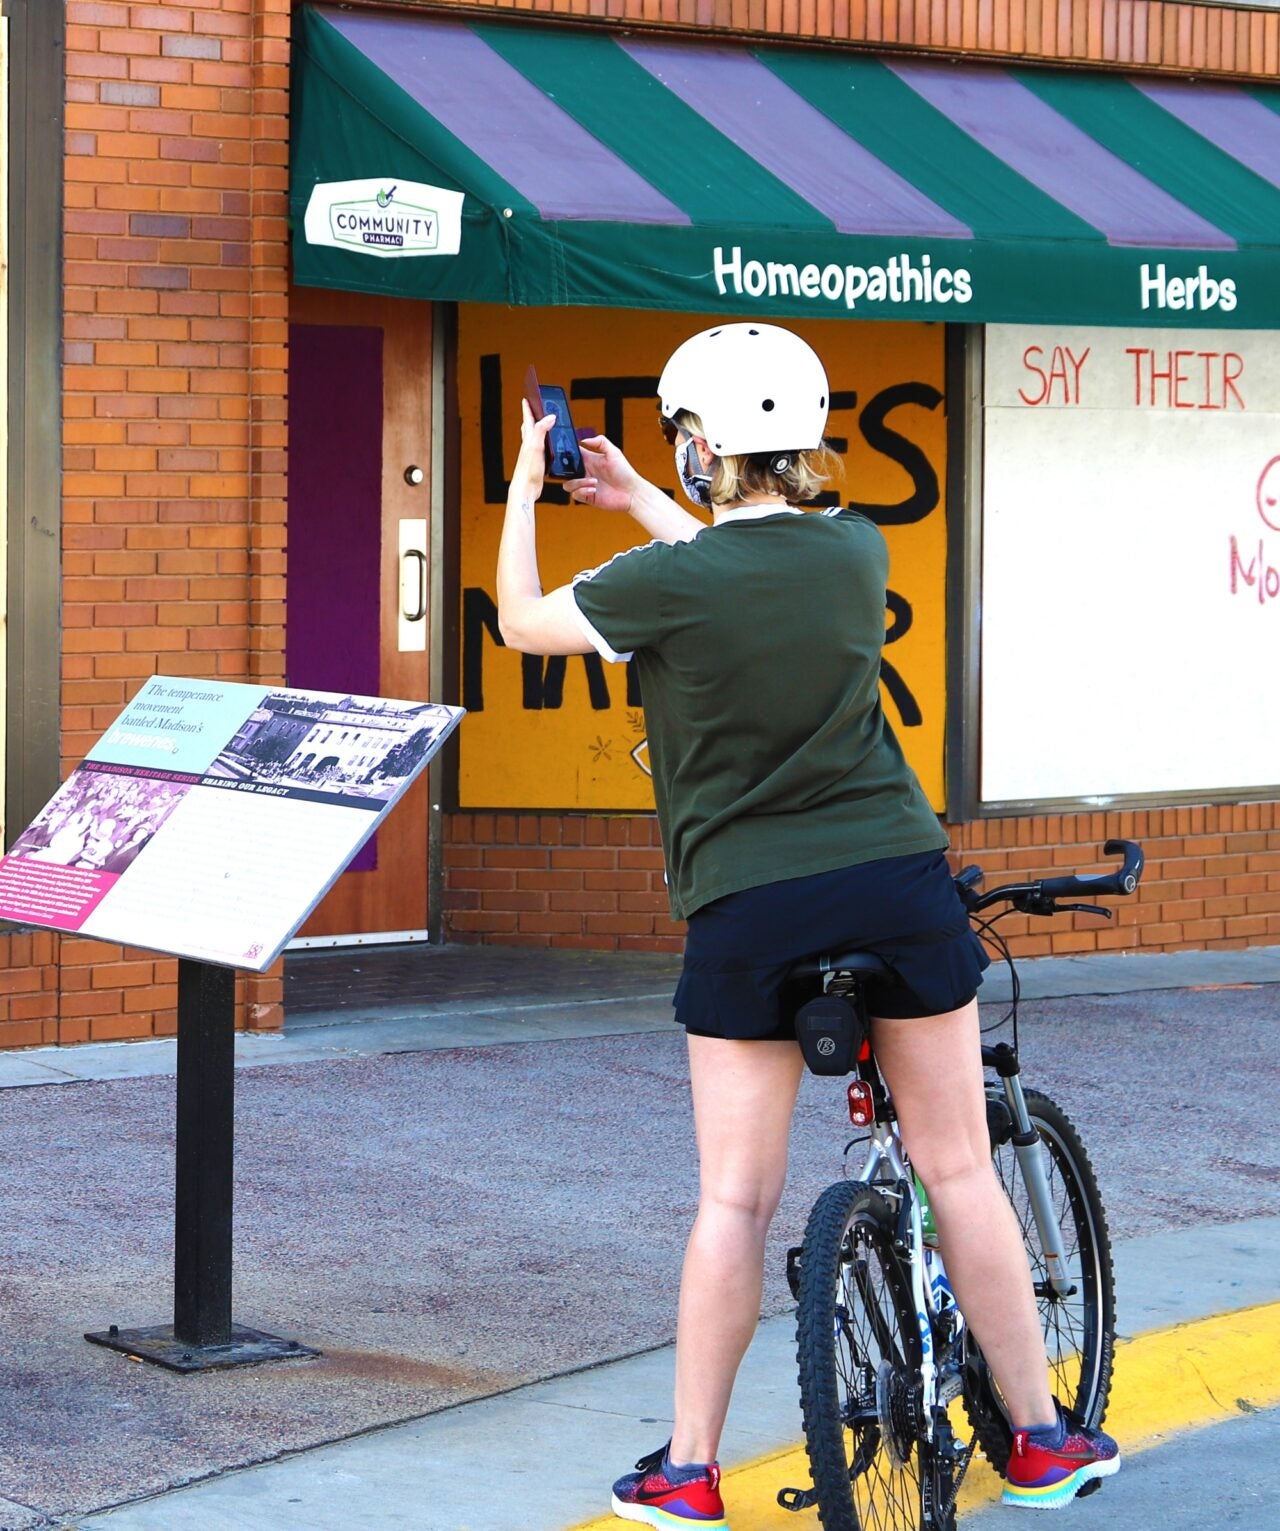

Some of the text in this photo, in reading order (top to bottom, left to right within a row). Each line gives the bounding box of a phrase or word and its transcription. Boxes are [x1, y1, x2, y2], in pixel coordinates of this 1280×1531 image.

[336, 213, 433, 236] COMMUNITY
[713, 246, 973, 309] Homeopathics
[1139, 263, 1238, 312] Herbs
[1018, 345, 1246, 410] SAY THEIR
[147, 684, 224, 702] The temperance
[133, 702, 184, 715] movement
[121, 714, 204, 734] battled Madison's
[85, 762, 290, 796] THE MADISON HERITAGE SERIES SHARING OUR LEGACY
